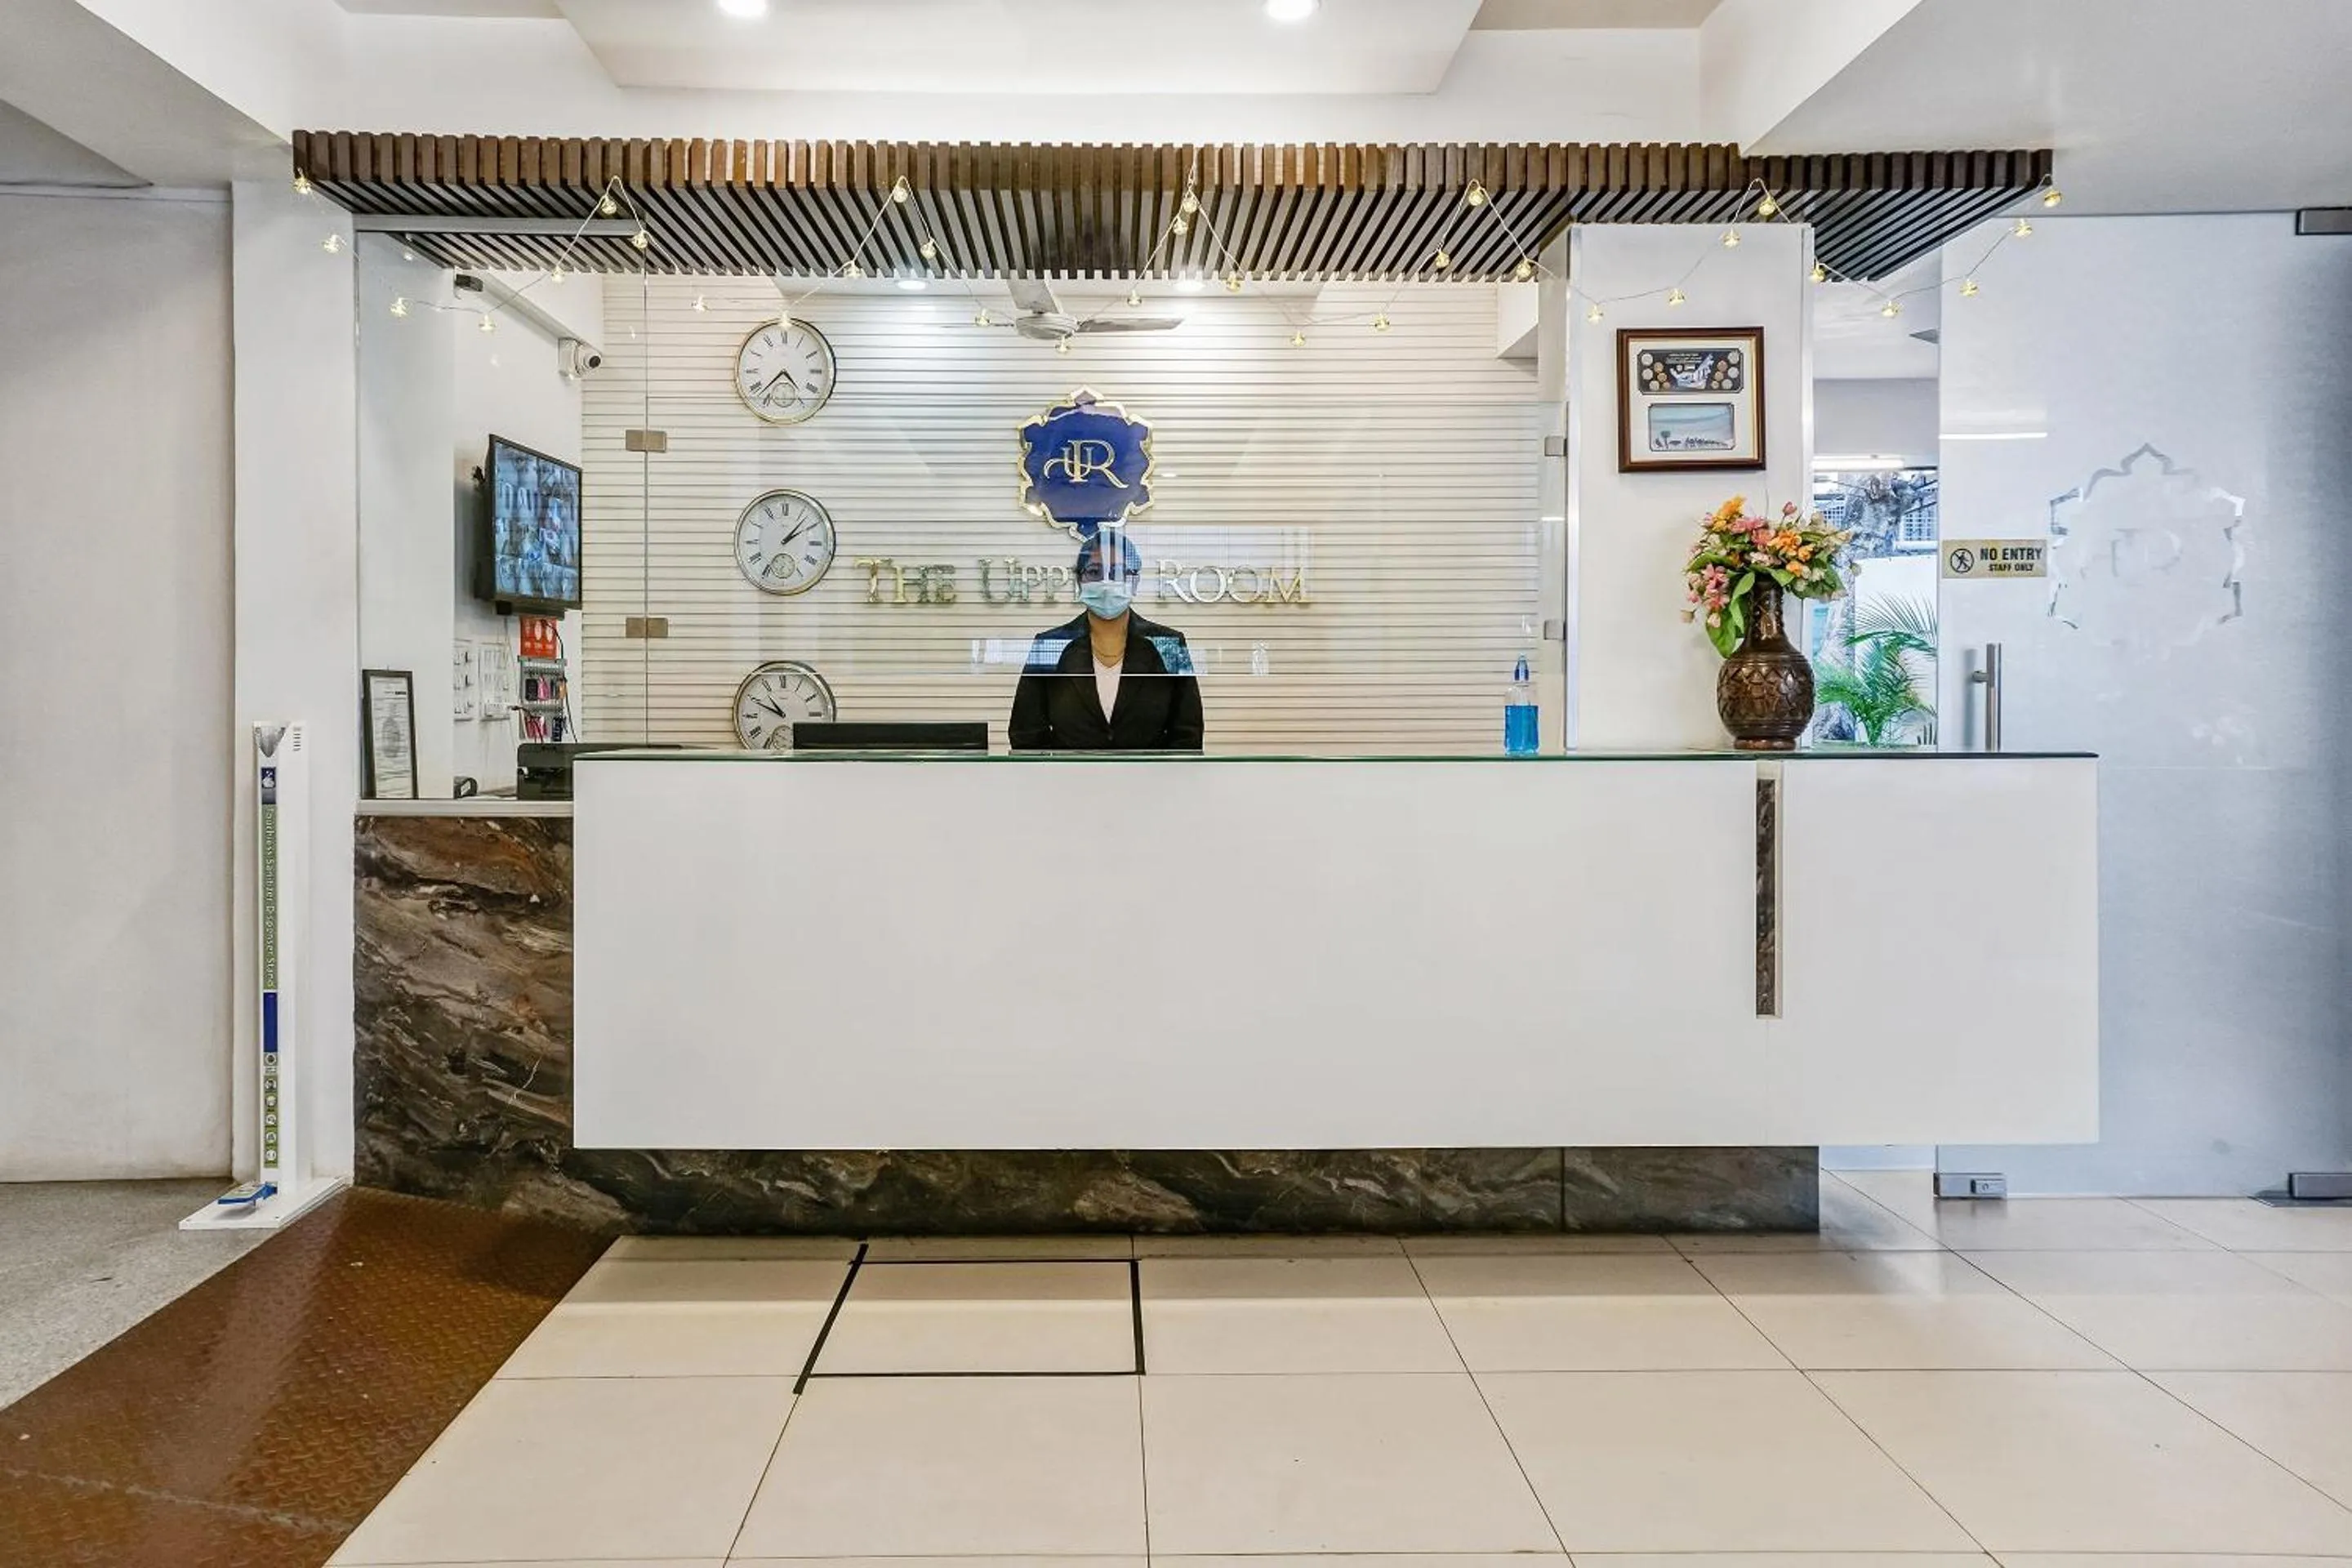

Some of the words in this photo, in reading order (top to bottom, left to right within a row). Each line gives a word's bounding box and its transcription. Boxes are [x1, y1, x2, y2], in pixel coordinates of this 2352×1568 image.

[1980, 548, 1998, 560] NO
[2002, 547, 2042, 560] ENTRY
[1156, 559, 1310, 604] ROOM
